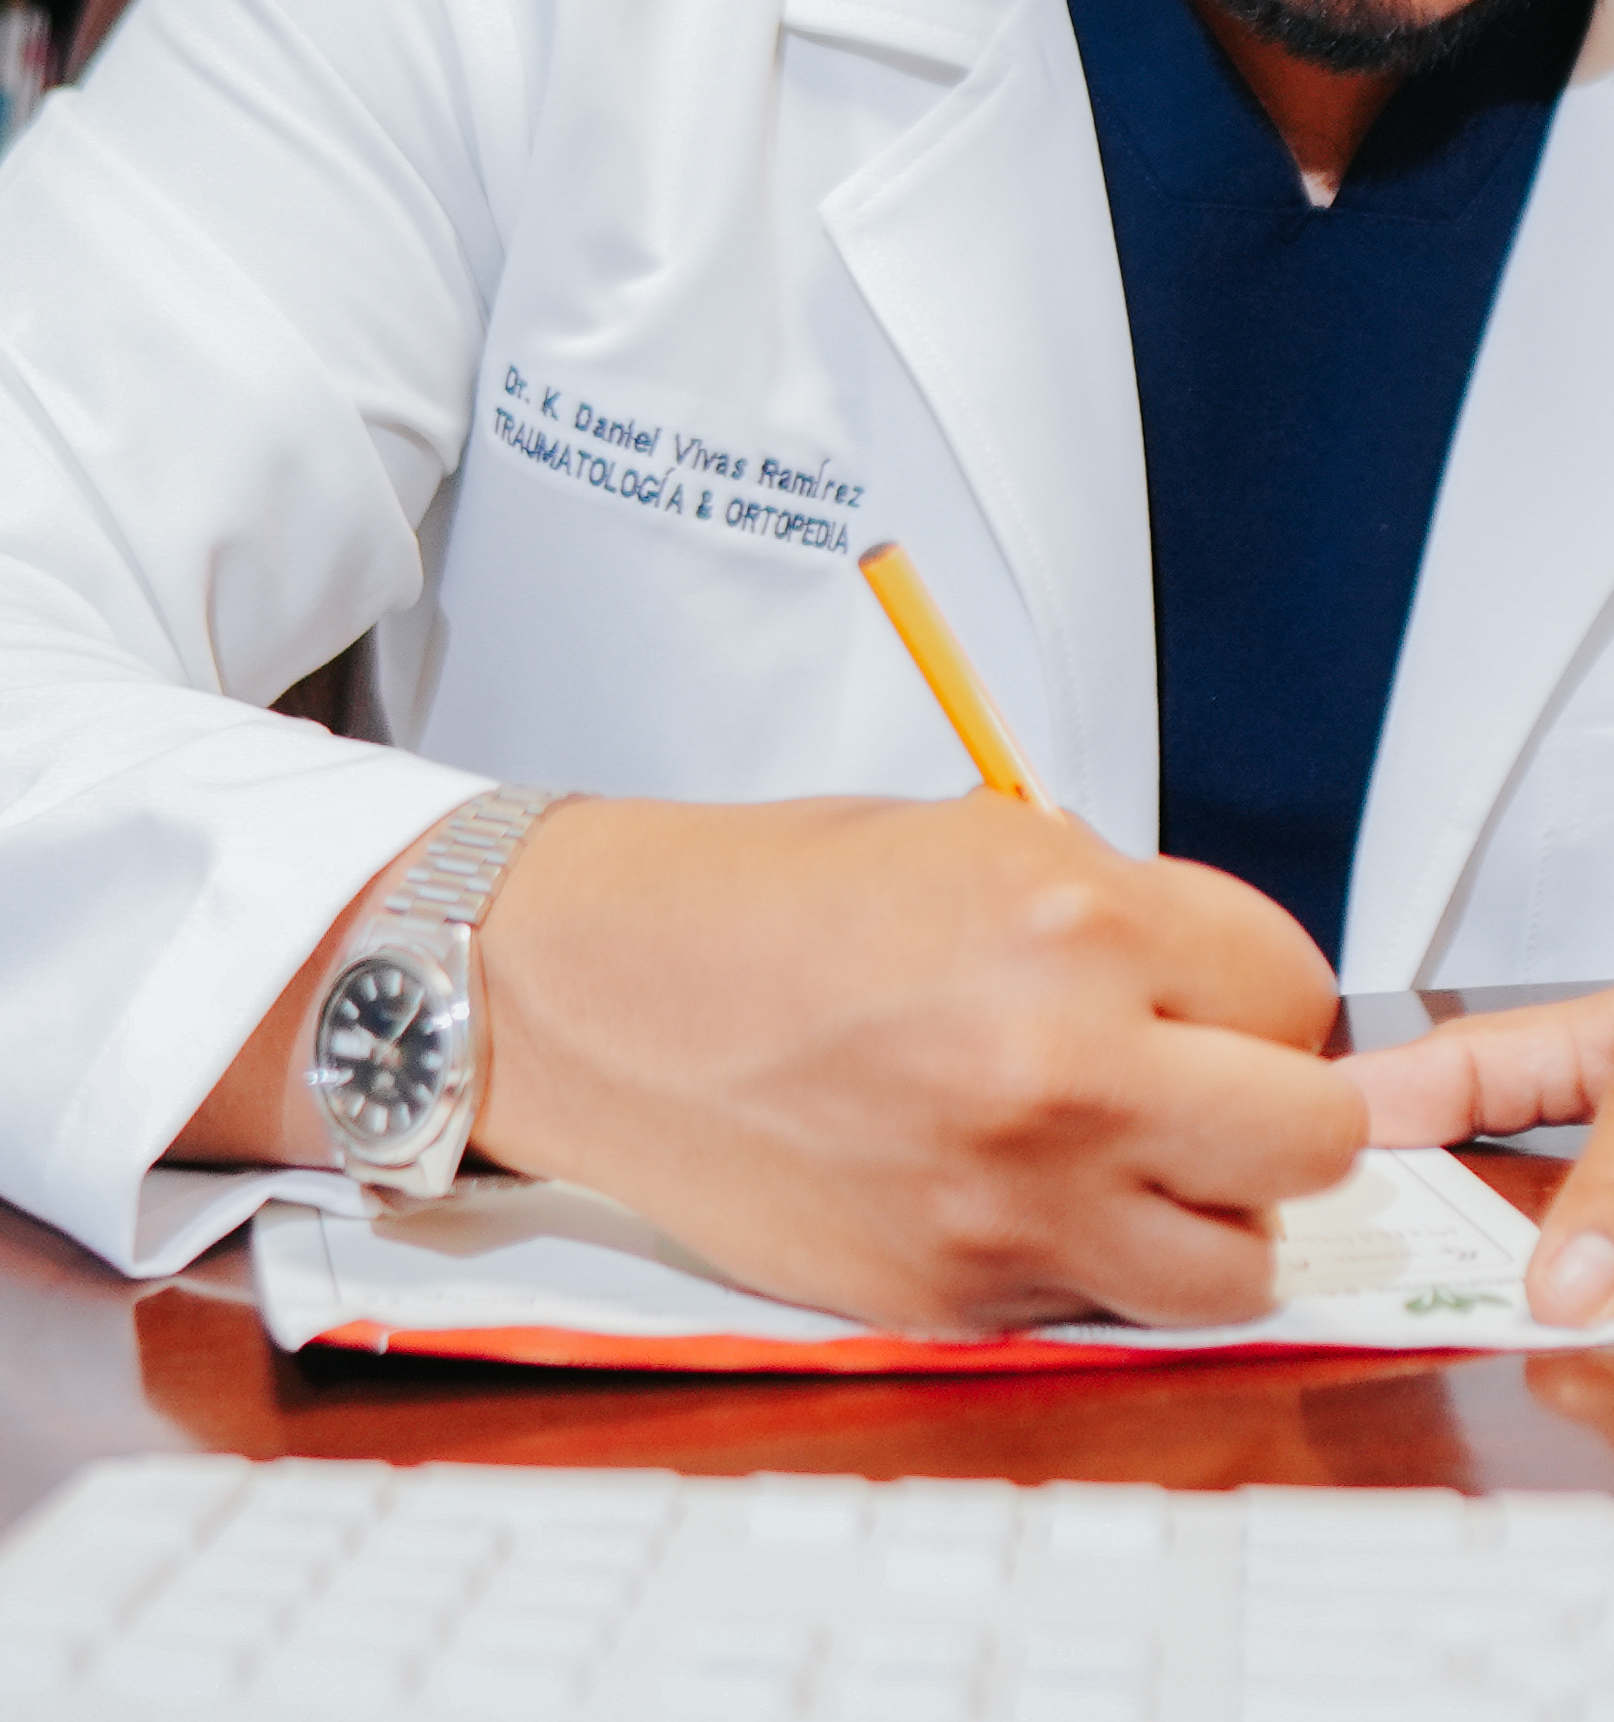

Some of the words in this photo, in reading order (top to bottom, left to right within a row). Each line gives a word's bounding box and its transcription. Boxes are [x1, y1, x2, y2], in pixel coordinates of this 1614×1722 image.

[494, 406, 684, 515] TRAUMATOLOGÍA
[695, 489, 714, 521] &
[725, 497, 849, 555] ORTOPEDIA
[505, 364, 530, 405] Dr.
[541, 385, 561, 421] K
[574, 402, 662, 457] Daniel
[675, 432, 747, 481] Vivas
[758, 457, 865, 508] Ramírez
